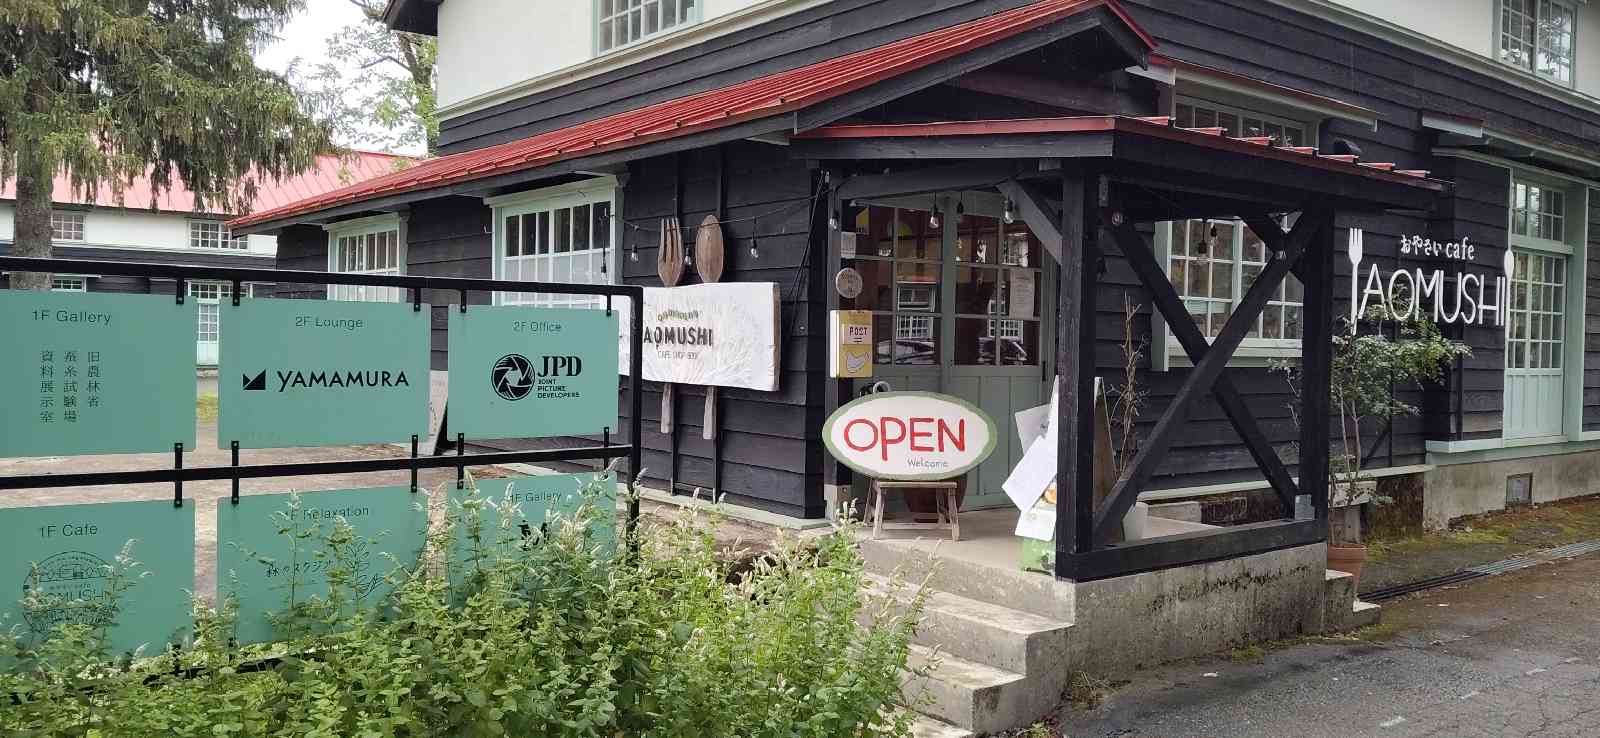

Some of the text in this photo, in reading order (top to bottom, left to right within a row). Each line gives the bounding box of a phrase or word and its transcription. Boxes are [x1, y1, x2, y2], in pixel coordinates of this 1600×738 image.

[1400, 234, 1475, 260] おやさい cafe
[1358, 263, 1506, 326] AOMUSHI
[32, 309, 112, 325] 1F Gallery
[295, 316, 364, 330] 2F Lounge
[512, 320, 562, 332] 2F Office
[643, 325, 714, 348] AOMUSHI
[849, 326, 869, 336] POST
[537, 355, 582, 378] JPD
[277, 369, 409, 393] YAMAMURA
[843, 416, 966, 462] OPEN
[907, 455, 948, 468] Welcome
[40, 524, 98, 538] 1F Cafe
